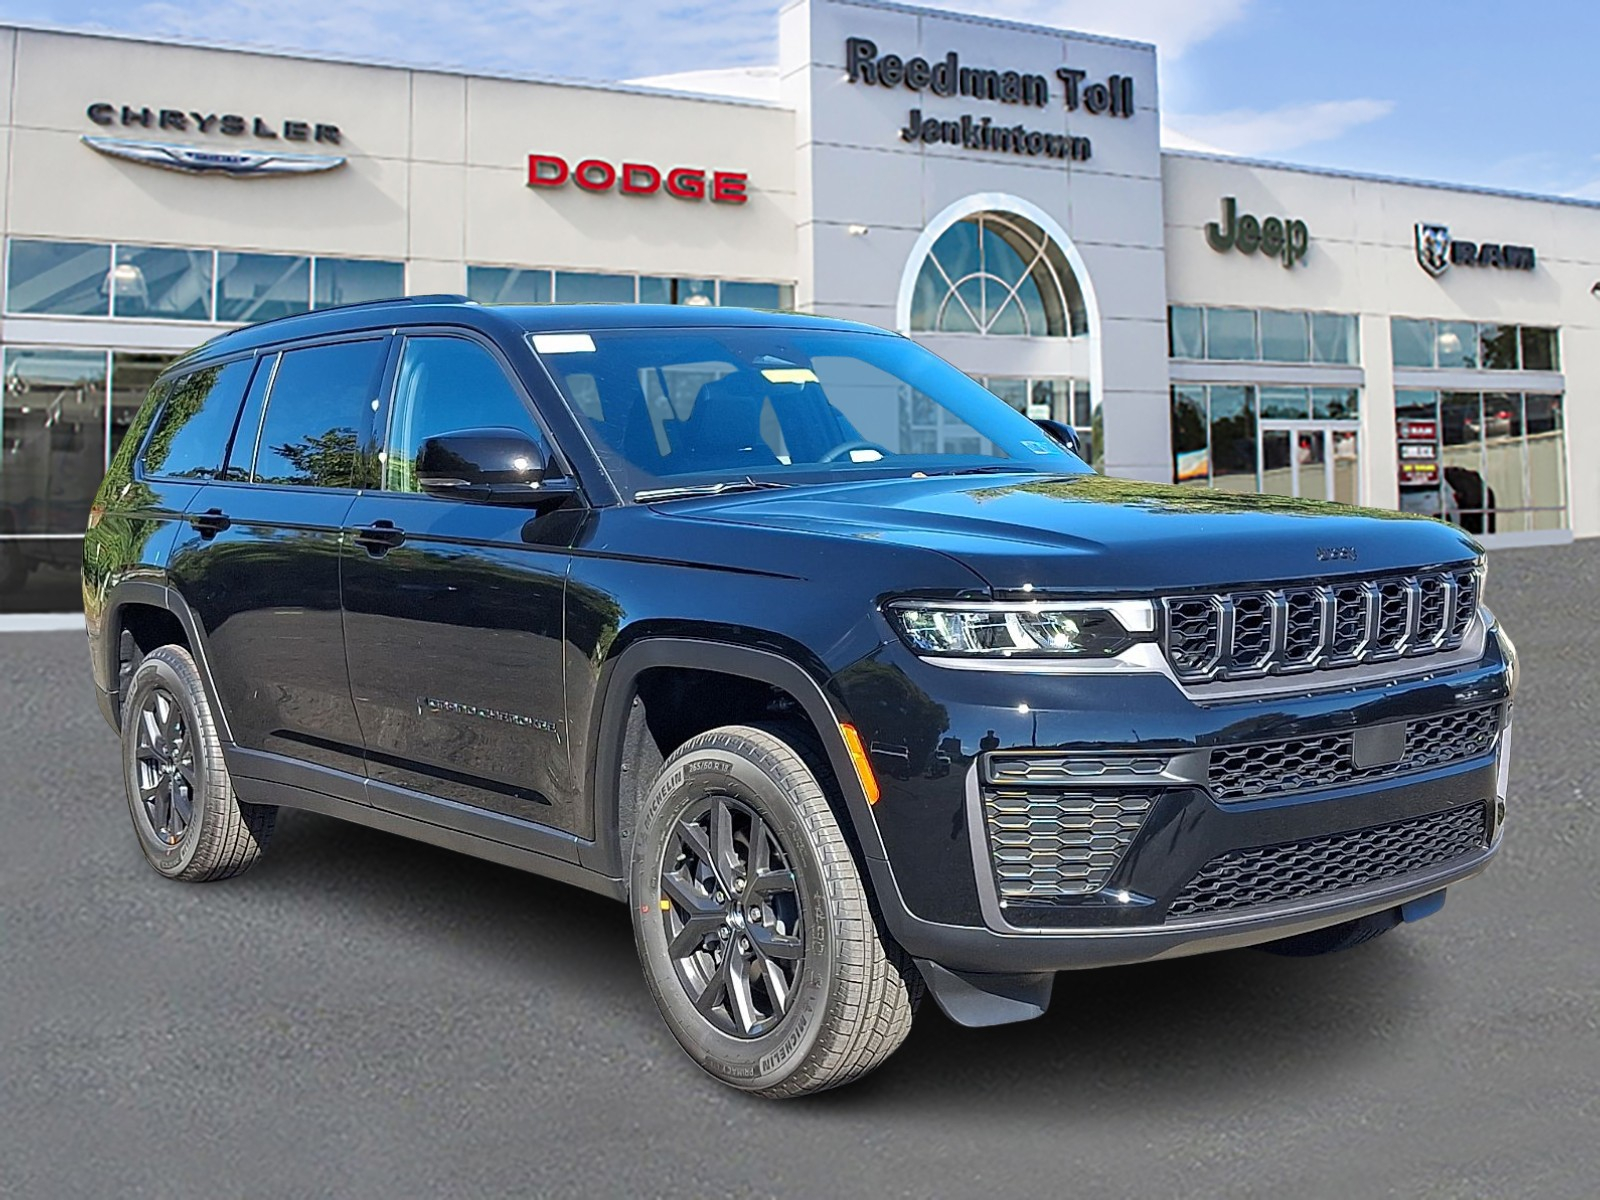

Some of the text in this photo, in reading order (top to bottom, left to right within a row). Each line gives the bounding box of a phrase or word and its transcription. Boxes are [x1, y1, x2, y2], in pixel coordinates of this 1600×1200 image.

[846, 37, 1134, 118] Reedman Toll
[87, 102, 341, 145] CHRYSLER
[901, 109, 1092, 161] Jenkintown
[527, 154, 748, 204] DODGE
[1204, 197, 1308, 269] Jeep
[1451, 241, 1535, 270] RAM
[762, 1014, 809, 1072] MICHELIN
